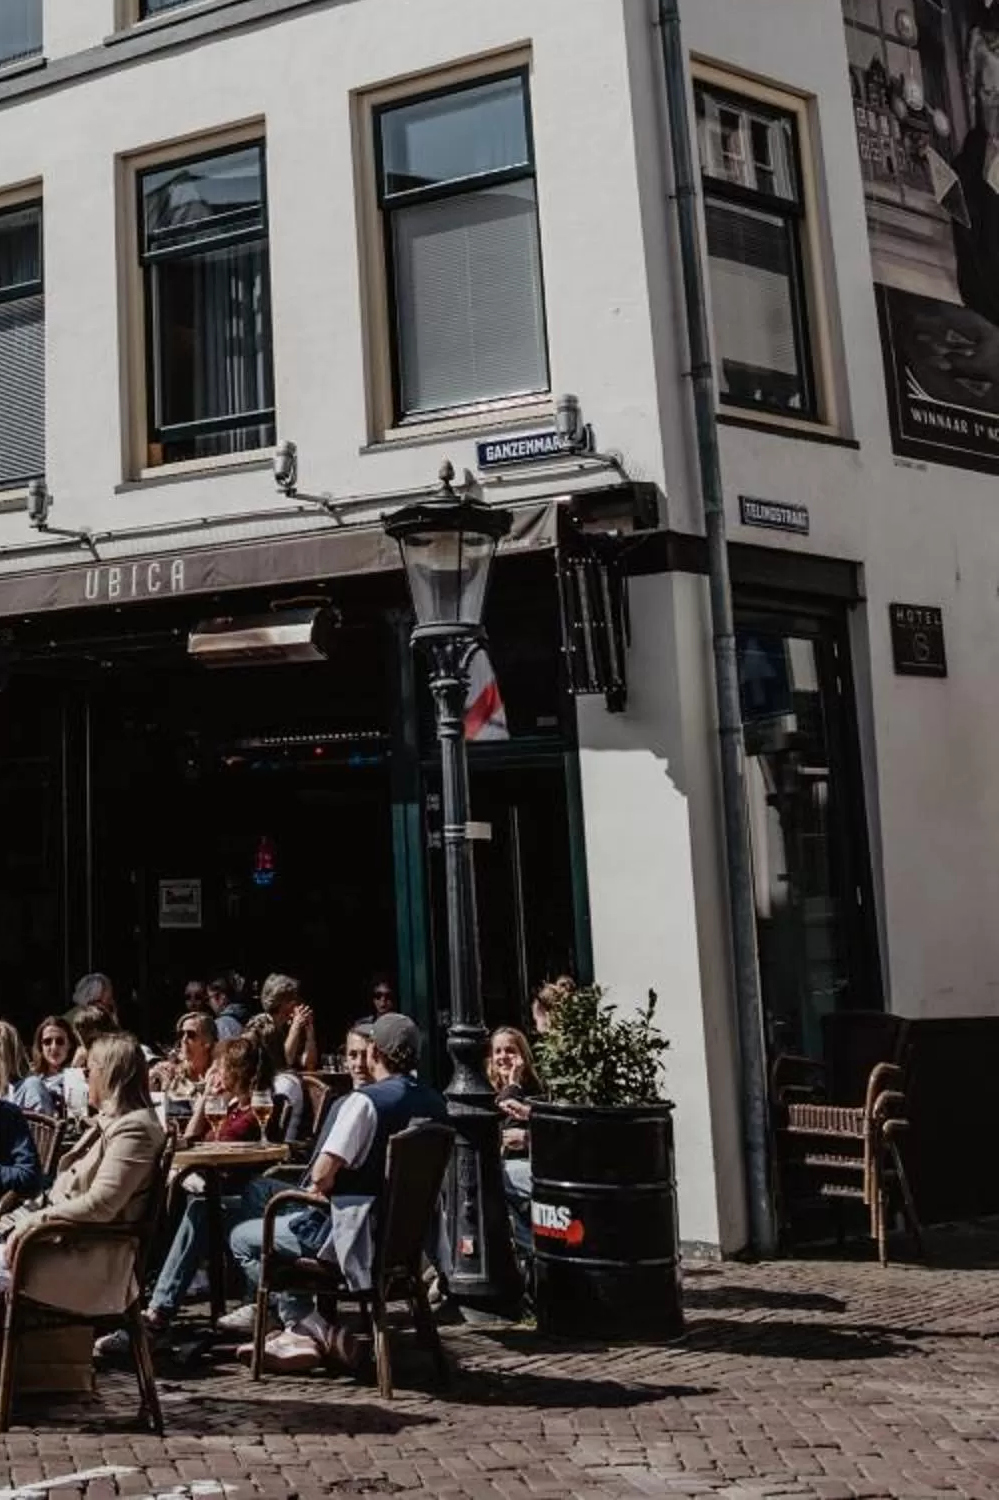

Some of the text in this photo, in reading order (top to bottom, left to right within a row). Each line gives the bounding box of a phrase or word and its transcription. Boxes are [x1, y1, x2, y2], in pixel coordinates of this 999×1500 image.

[486, 435, 568, 461] GANZENMAR
[85, 559, 185, 601] UBICA
[896, 606, 942, 625] HOTEL
[531, 1200, 571, 1231] ITAS
